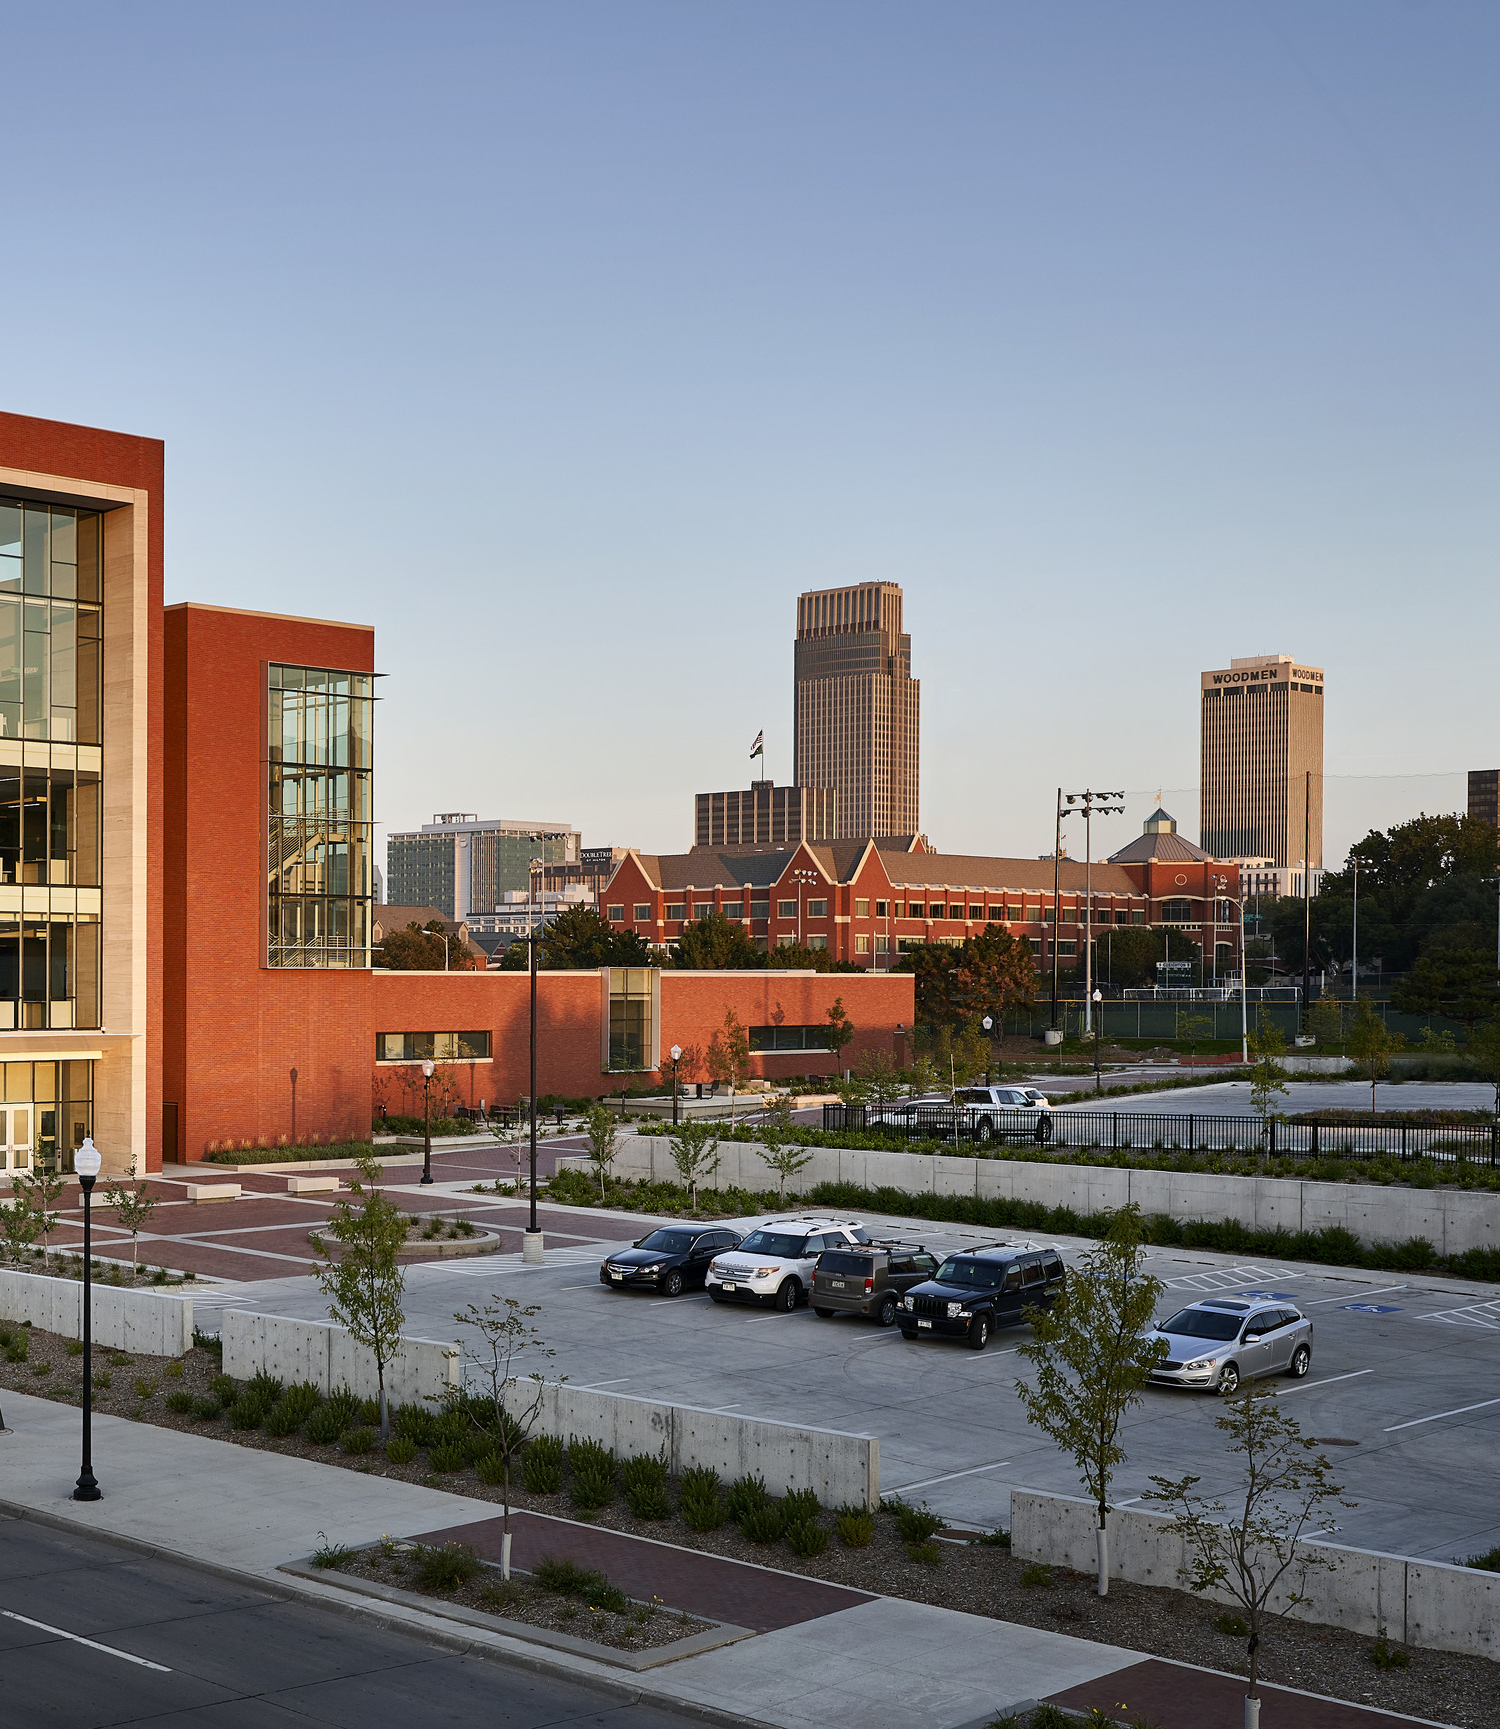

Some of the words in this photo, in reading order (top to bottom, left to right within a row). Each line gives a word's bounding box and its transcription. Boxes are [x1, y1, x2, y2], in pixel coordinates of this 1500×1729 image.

[1213, 669, 1277, 684] WOODMEN
[1292, 668, 1324, 682] WOODMEN
[580, 851, 612, 859] DOUBLETREE
